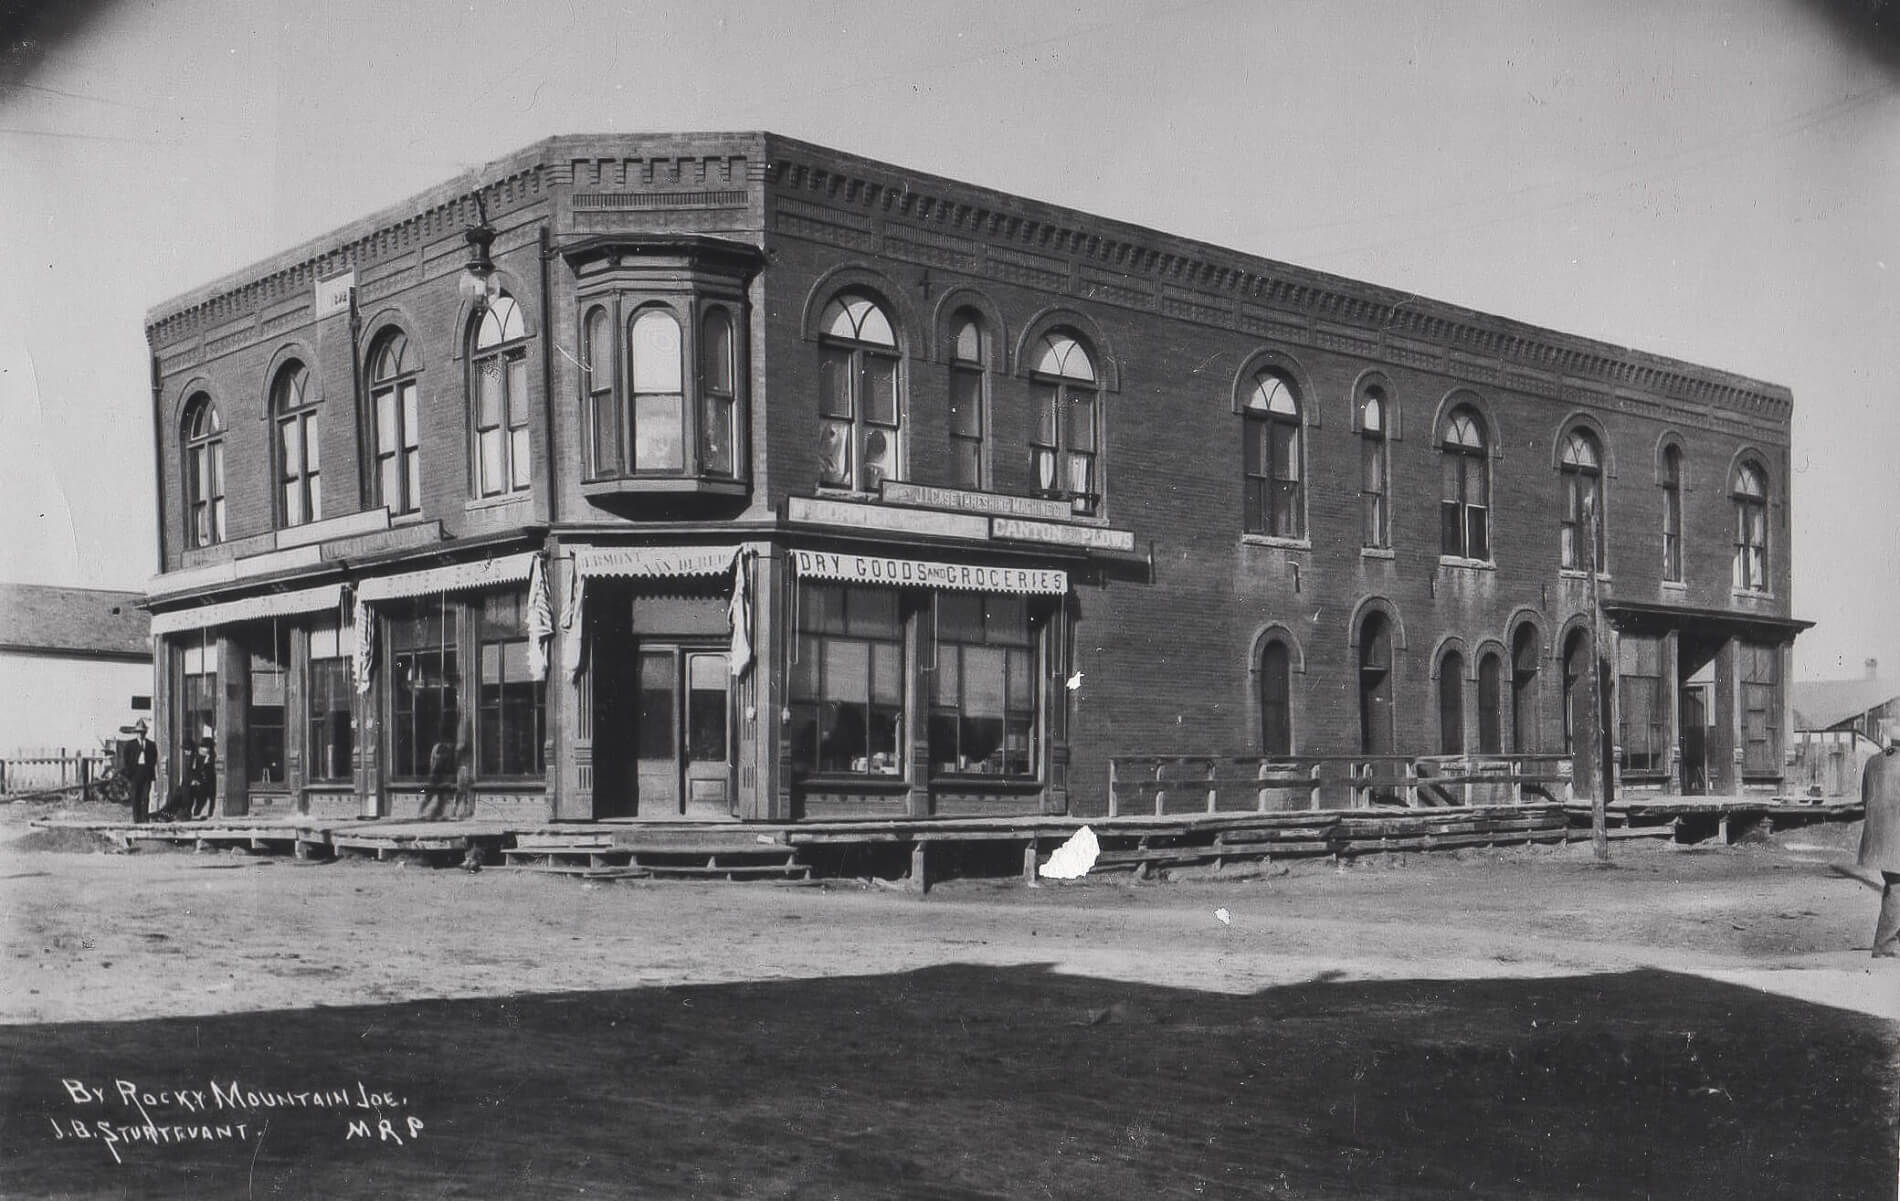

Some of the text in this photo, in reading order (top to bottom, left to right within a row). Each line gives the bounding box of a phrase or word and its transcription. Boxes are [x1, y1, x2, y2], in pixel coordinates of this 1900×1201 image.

[993, 518, 1063, 543] CANTON
[800, 552, 1062, 590] DRY GOODS AND GROCERIES
